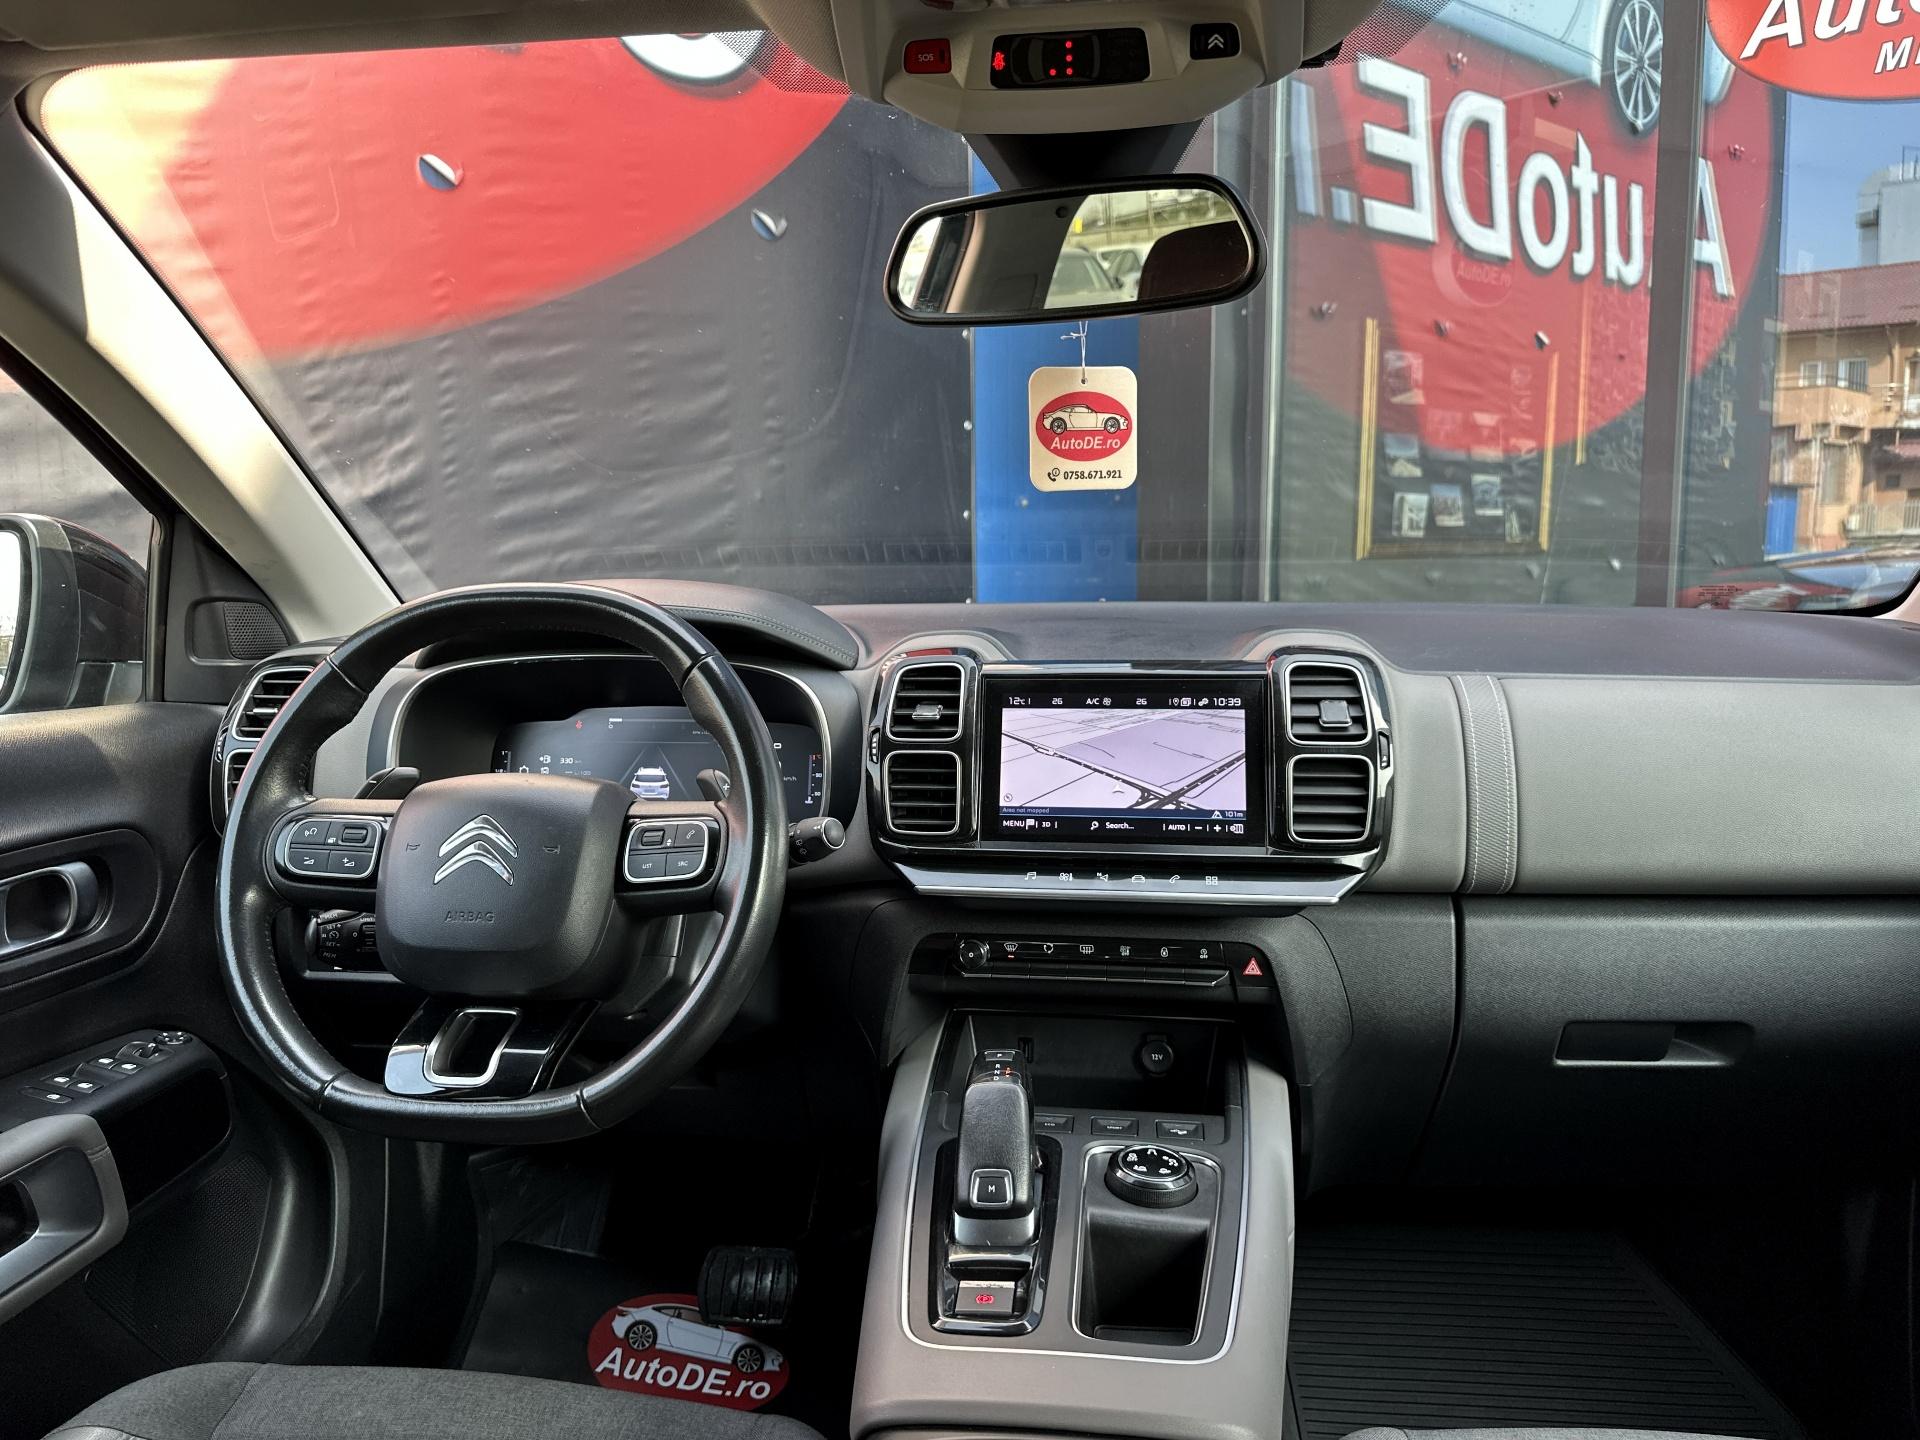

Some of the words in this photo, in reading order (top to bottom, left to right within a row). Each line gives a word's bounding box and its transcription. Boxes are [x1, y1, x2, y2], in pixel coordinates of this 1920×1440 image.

[918, 53, 934, 62] SOS
[1874, 36, 1920, 74] M
[1050, 436, 1121, 450] AutoDE.ro
[1063, 469, 1123, 480] 0758.671.921
[1052, 697, 1063, 705] 26
[1086, 697, 1099, 705] A/C
[1136, 698, 1148, 706] 26
[1213, 698, 1241, 706] 10:39
[444, 911, 496, 924] AIRBAG
[1151, 1053, 1164, 1061] 12V
[987, 1185, 996, 1193] M
[594, 1346, 771, 1401] AutoDE.ro
